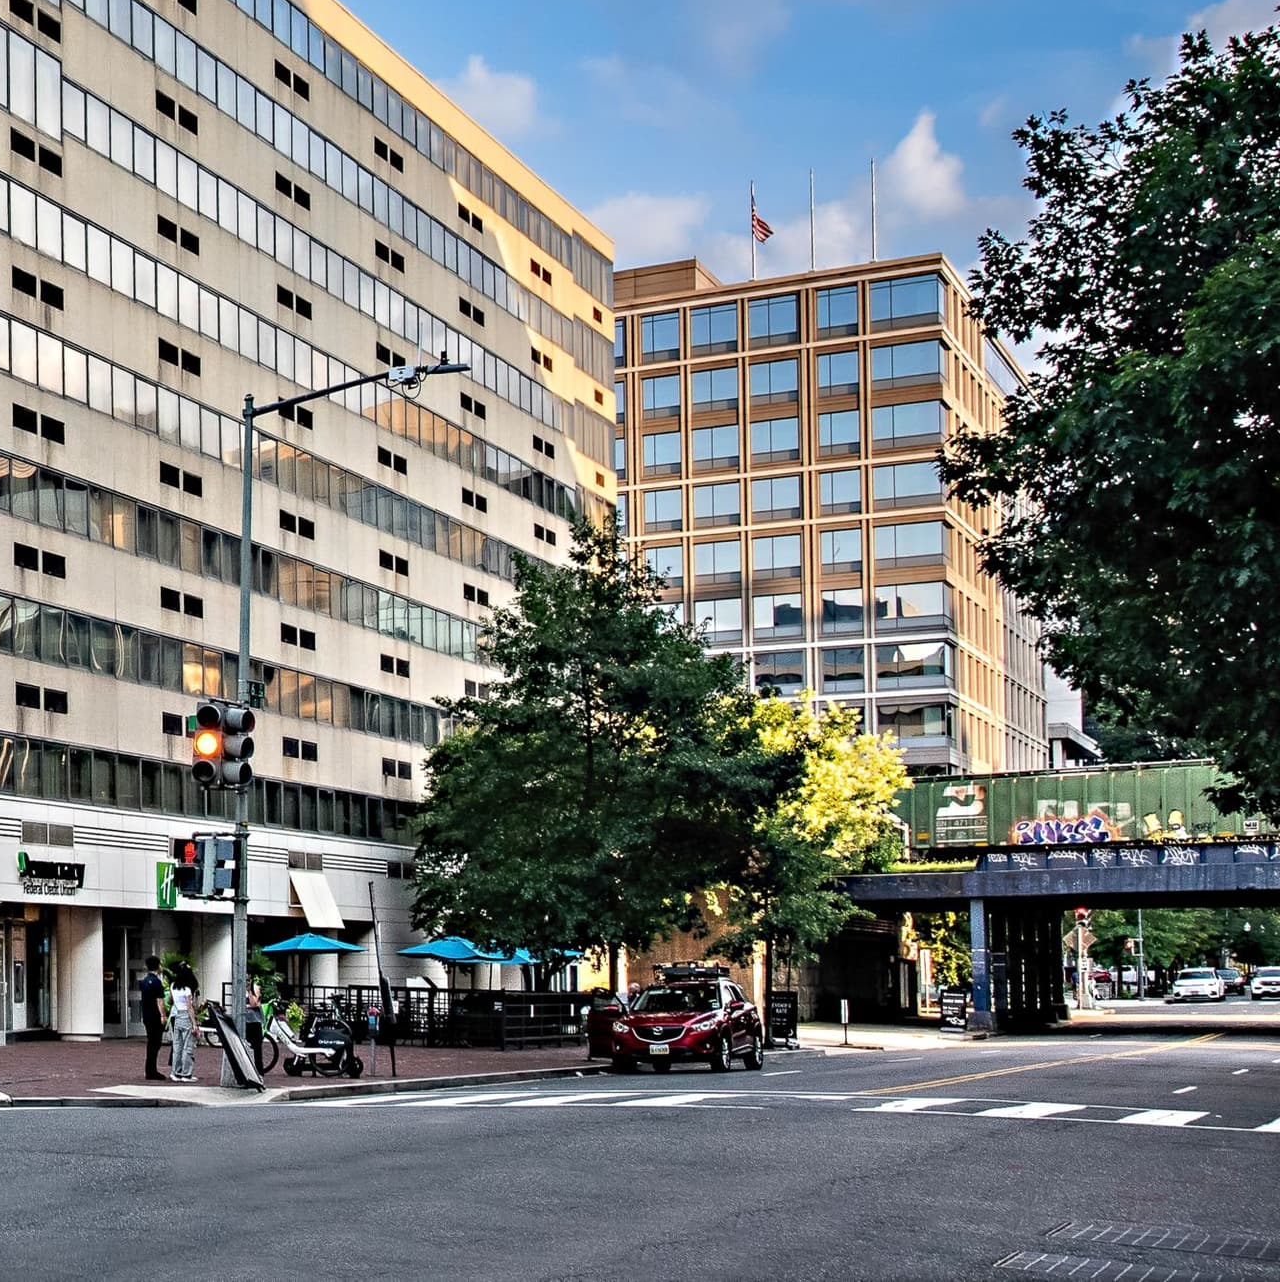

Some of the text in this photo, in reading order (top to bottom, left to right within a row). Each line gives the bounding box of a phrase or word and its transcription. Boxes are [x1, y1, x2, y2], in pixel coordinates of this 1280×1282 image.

[23, 882, 76, 897] Federal Credit Union
